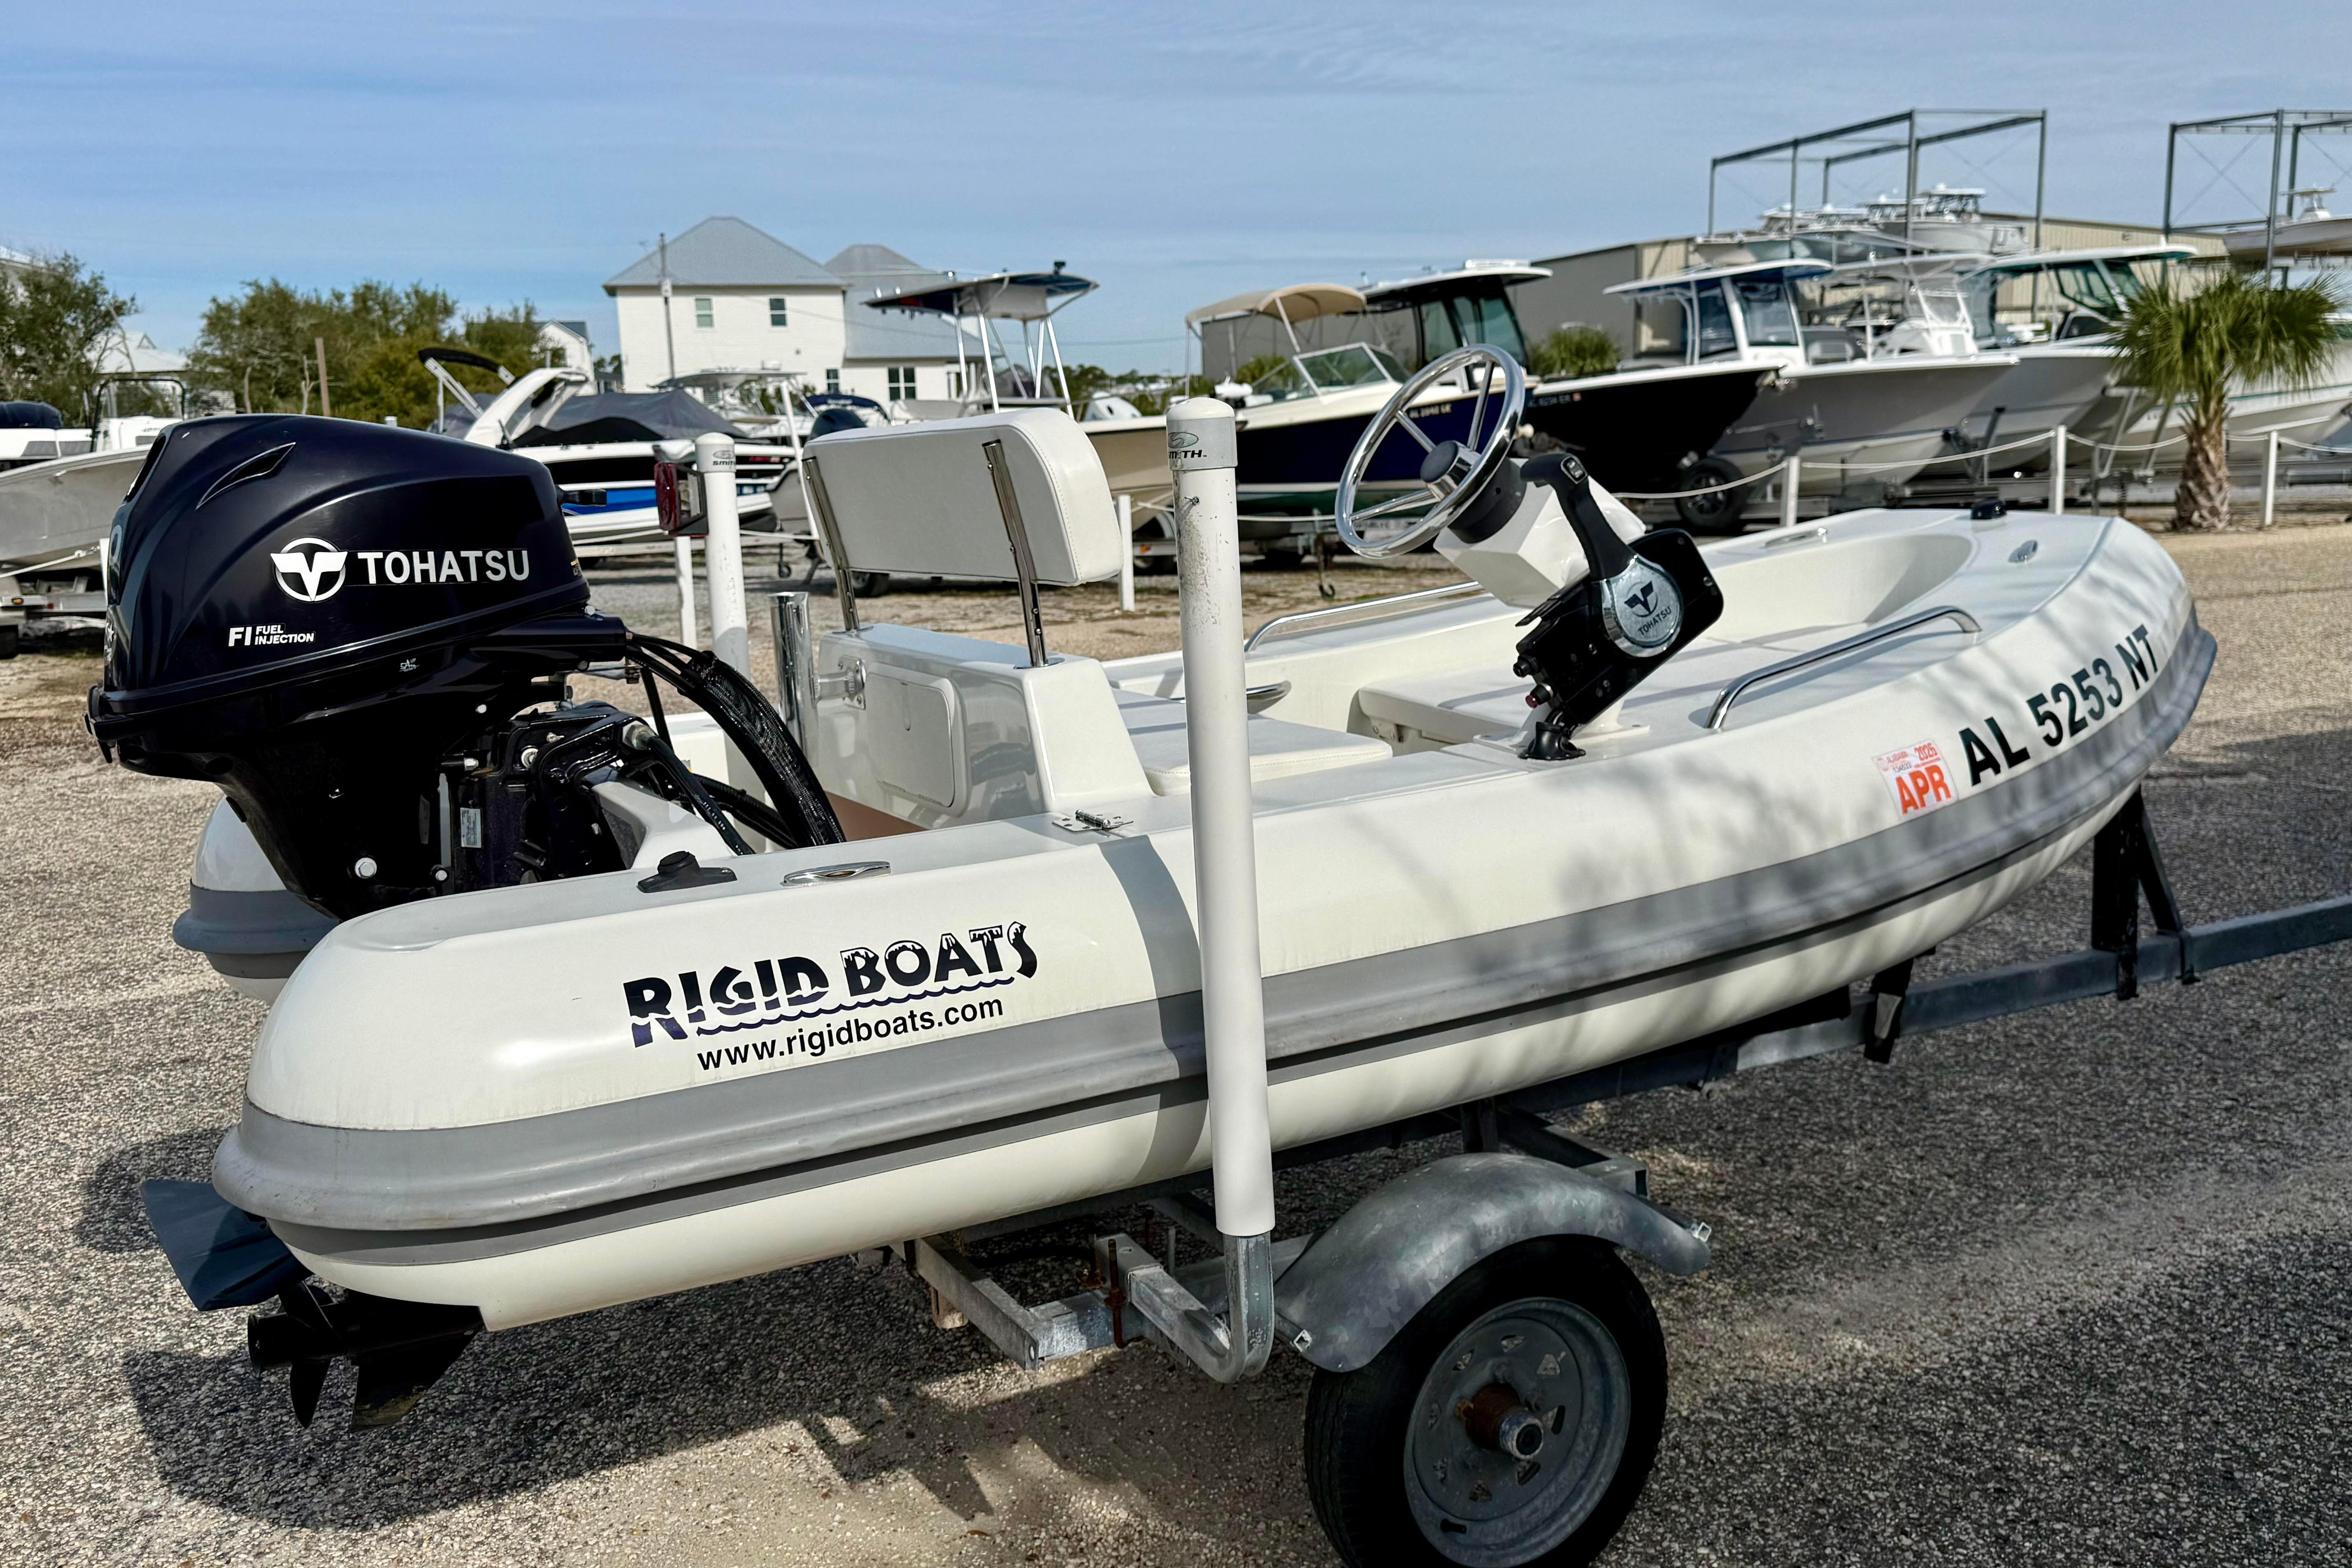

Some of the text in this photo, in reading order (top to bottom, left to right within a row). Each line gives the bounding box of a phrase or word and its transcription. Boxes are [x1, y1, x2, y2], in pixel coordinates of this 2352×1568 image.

[357, 550, 530, 584] TOHATSU
[229, 627, 252, 647] FI
[255, 625, 284, 635] FUEL
[1638, 607, 1672, 635] TOHATSU
[254, 633, 315, 645] INJECTION
[1958, 624, 2159, 786] AL 5253 NT
[1895, 765, 1951, 815] APR
[623, 921, 1037, 1048] RIGID BOATS
[697, 997, 1003, 1071] www.rigidboats.com
